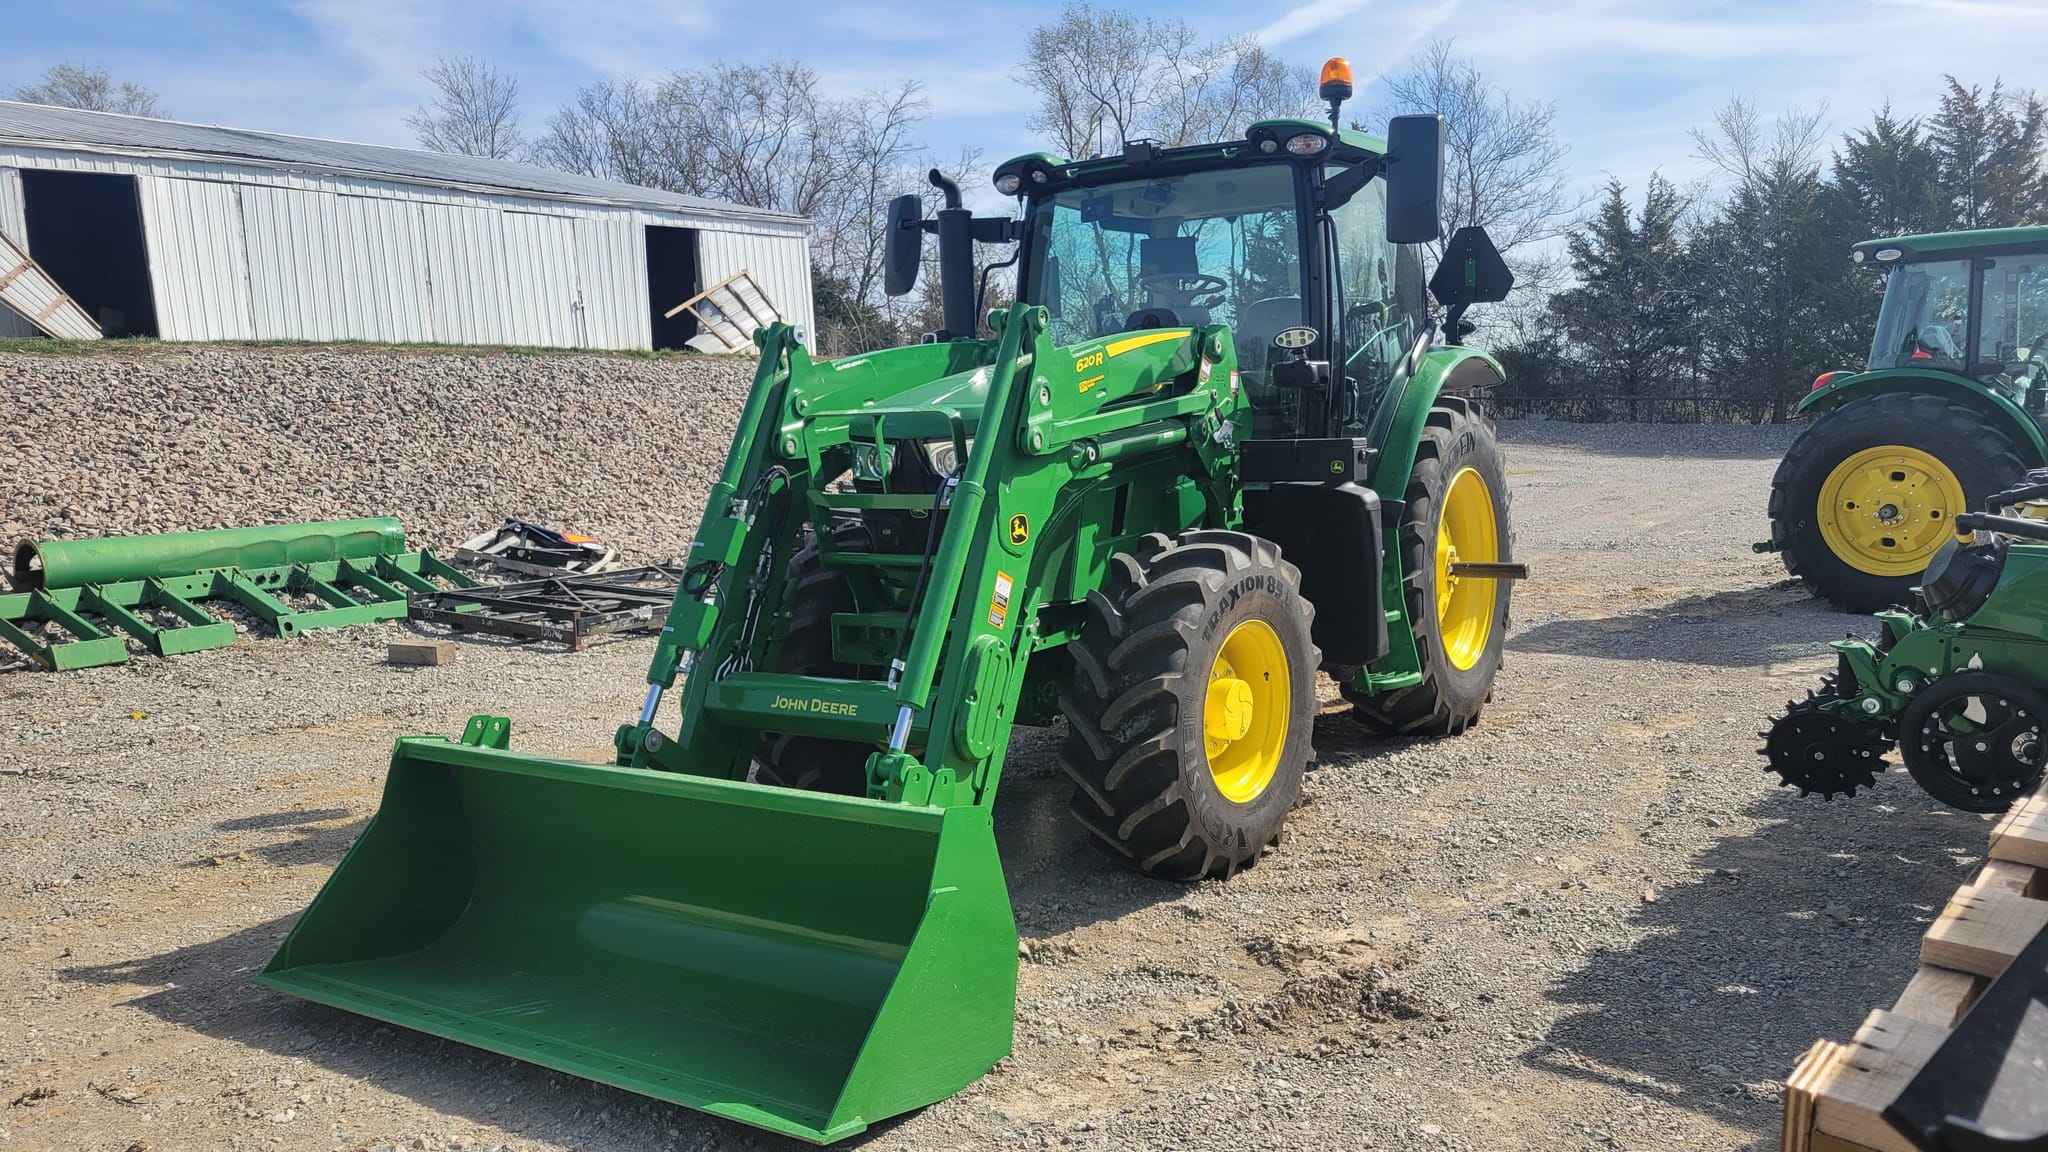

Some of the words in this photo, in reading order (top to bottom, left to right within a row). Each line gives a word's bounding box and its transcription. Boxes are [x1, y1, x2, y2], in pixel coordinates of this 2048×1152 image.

[1266, 575, 1284, 600] 85
[770, 695, 808, 711] JOHN
[810, 698, 858, 716] DEERE
